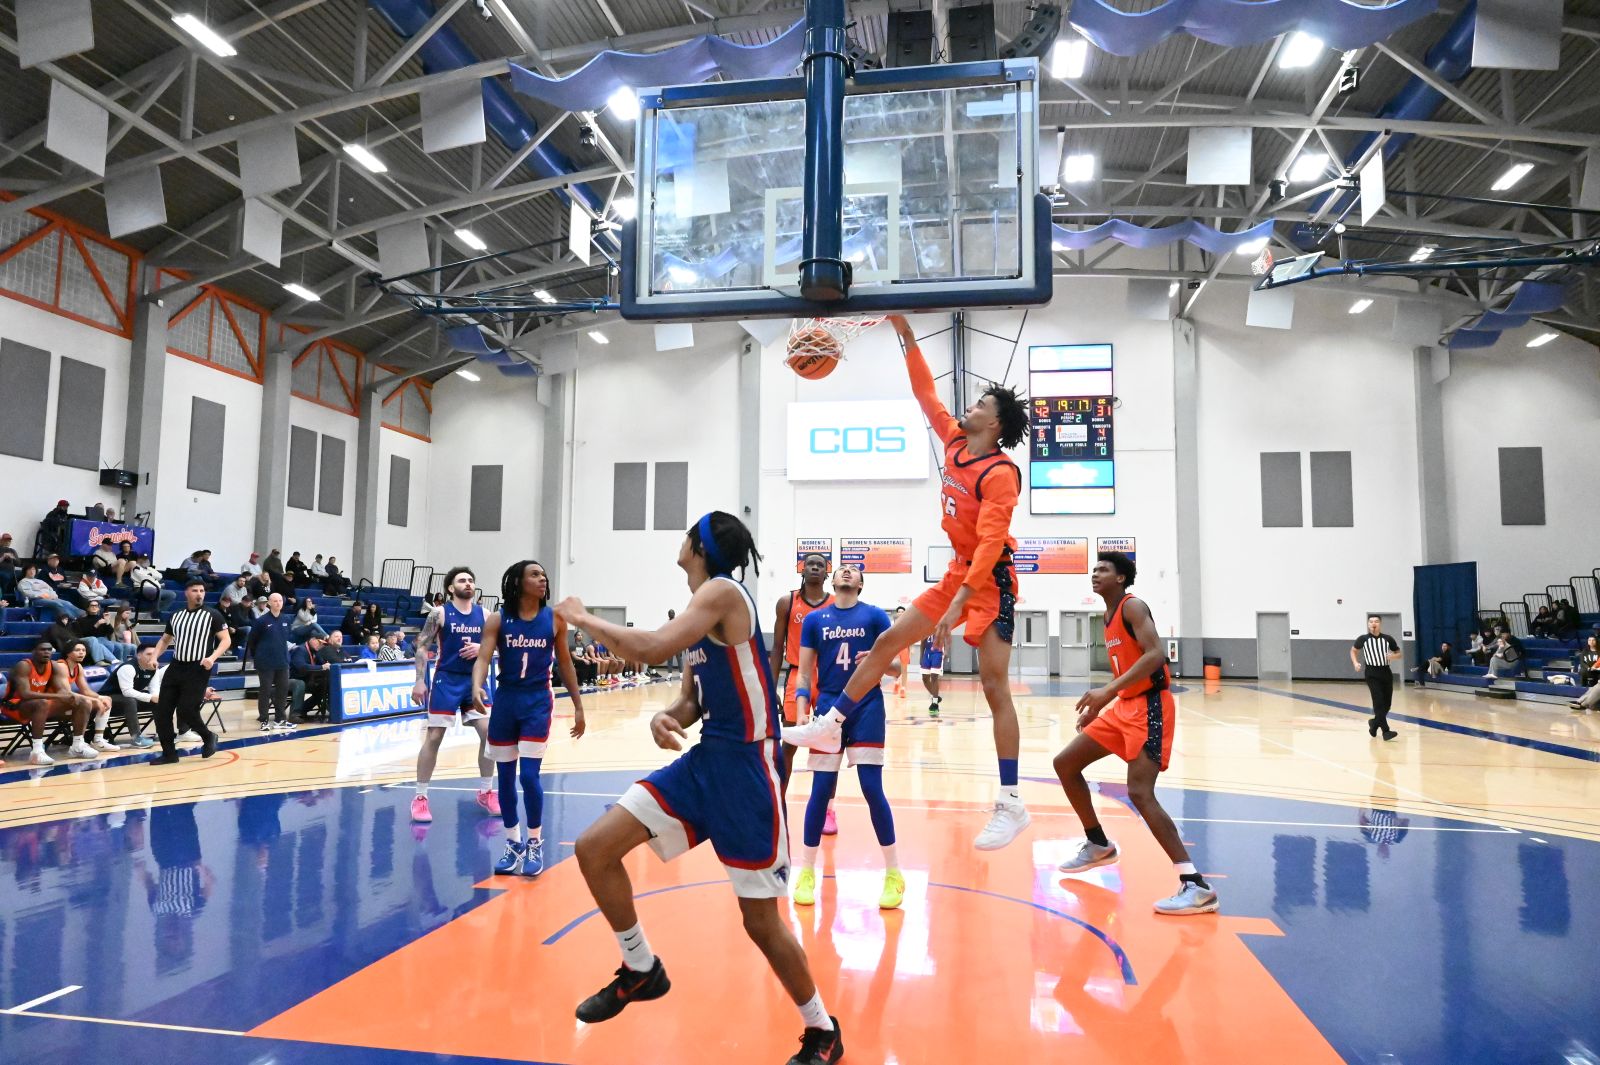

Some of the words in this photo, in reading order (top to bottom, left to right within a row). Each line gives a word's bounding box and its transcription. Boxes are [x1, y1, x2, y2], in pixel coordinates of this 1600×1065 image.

[1057, 400, 1089, 411] 19:17
[1097, 405, 1111, 417] 31
[1035, 406, 1049, 418] 42
[1075, 414, 1082, 423] 2
[1038, 429, 1046, 438] 6
[1098, 428, 1106, 437] 4
[809, 426, 906, 454] COS
[1042, 447, 1049, 456] 0
[1100, 446, 1107, 456] 0
[822, 626, 866, 640] Falcons
[505, 634, 547, 648] Falcons
[835, 642, 852, 671] 4
[520, 652, 529, 679] 1
